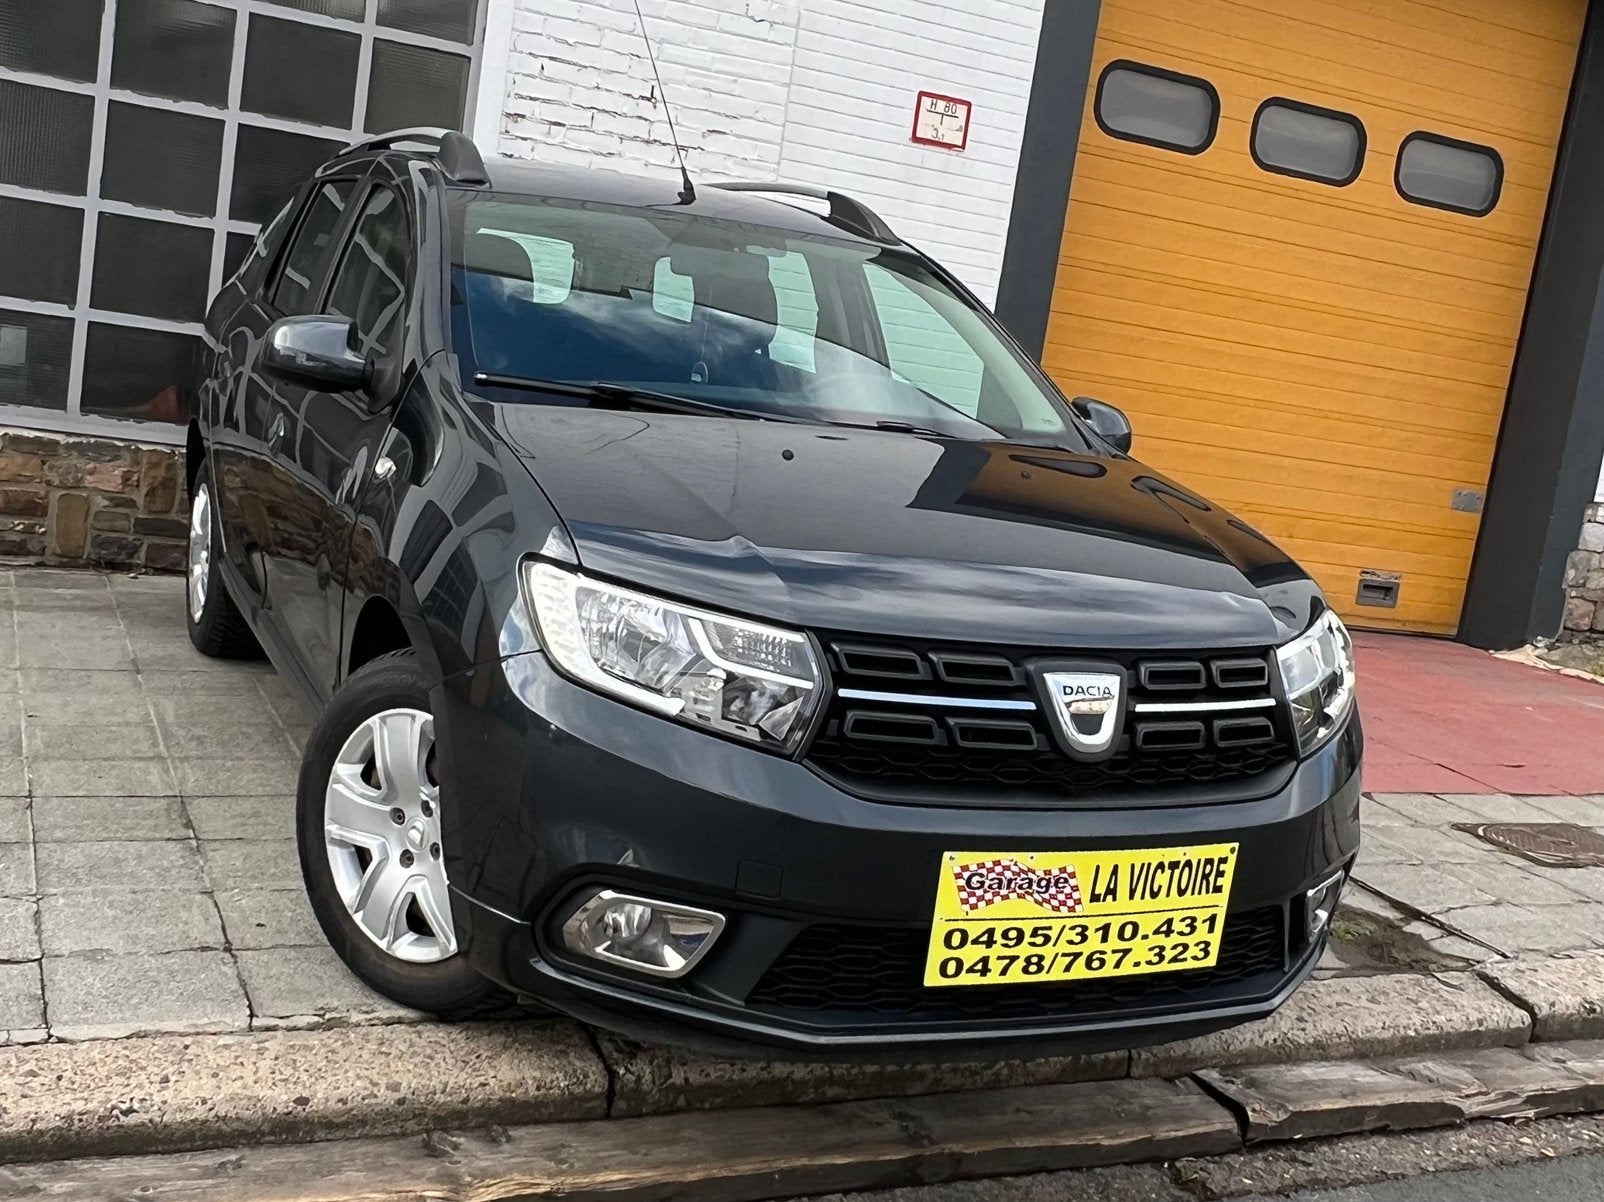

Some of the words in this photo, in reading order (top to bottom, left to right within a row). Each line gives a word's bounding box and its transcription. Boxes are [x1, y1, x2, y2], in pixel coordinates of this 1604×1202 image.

[930, 99, 938, 110] H
[943, 102, 957, 114] 80
[1062, 685, 1113, 697] DACIA
[965, 872, 1069, 894] Garage
[1089, 864, 1119, 903] LA
[1128, 856, 1229, 901] VICTOIRE
[943, 913, 1218, 950] 0495/310.431
[939, 940, 1212, 979] 0478/767.323
